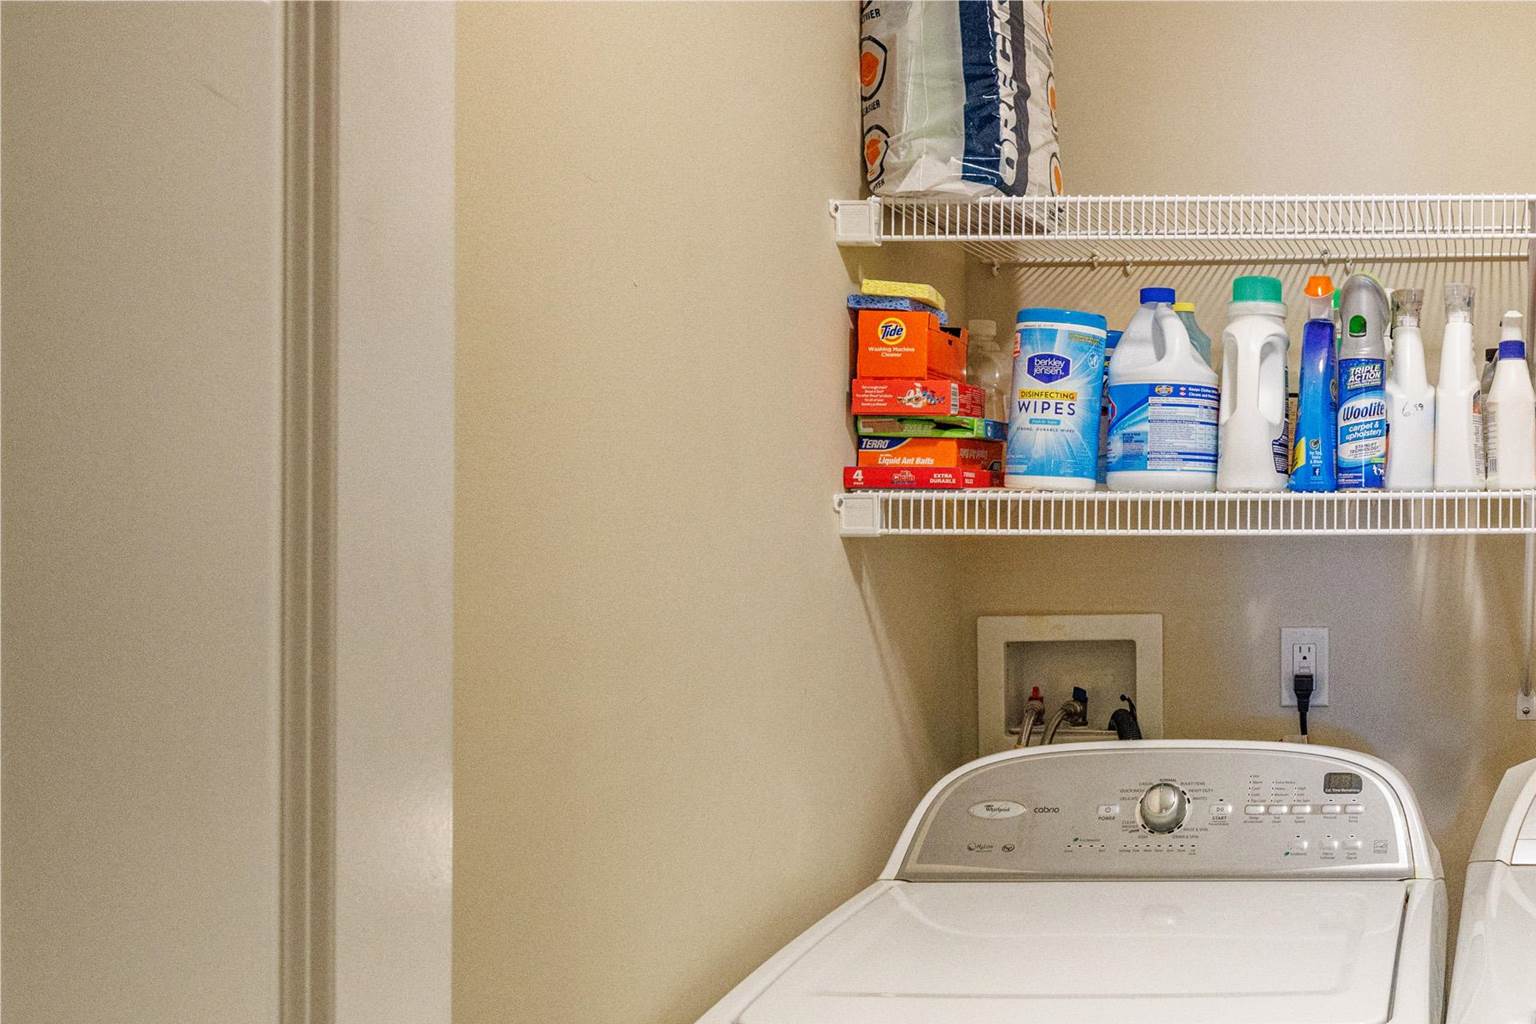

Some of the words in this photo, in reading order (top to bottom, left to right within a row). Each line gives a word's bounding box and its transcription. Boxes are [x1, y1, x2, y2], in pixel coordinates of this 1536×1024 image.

[881, 324, 903, 339] Tide
[1034, 357, 1065, 368] berkley
[1350, 364, 1380, 374] TRIPLE
[1348, 371, 1381, 382] ACTION
[1020, 390, 1075, 400] DISINFECTING
[1018, 400, 1076, 416] WIPES
[1342, 402, 1385, 422] Woolite
[1349, 422, 1373, 432] carpet
[1345, 429, 1382, 440] upholstery
[862, 439, 889, 449] TERRO
[878, 456, 901, 466] Liquid
[901, 457, 914, 465] Ant
[915, 457, 934, 465] Baits
[853, 470, 863, 481] 4
